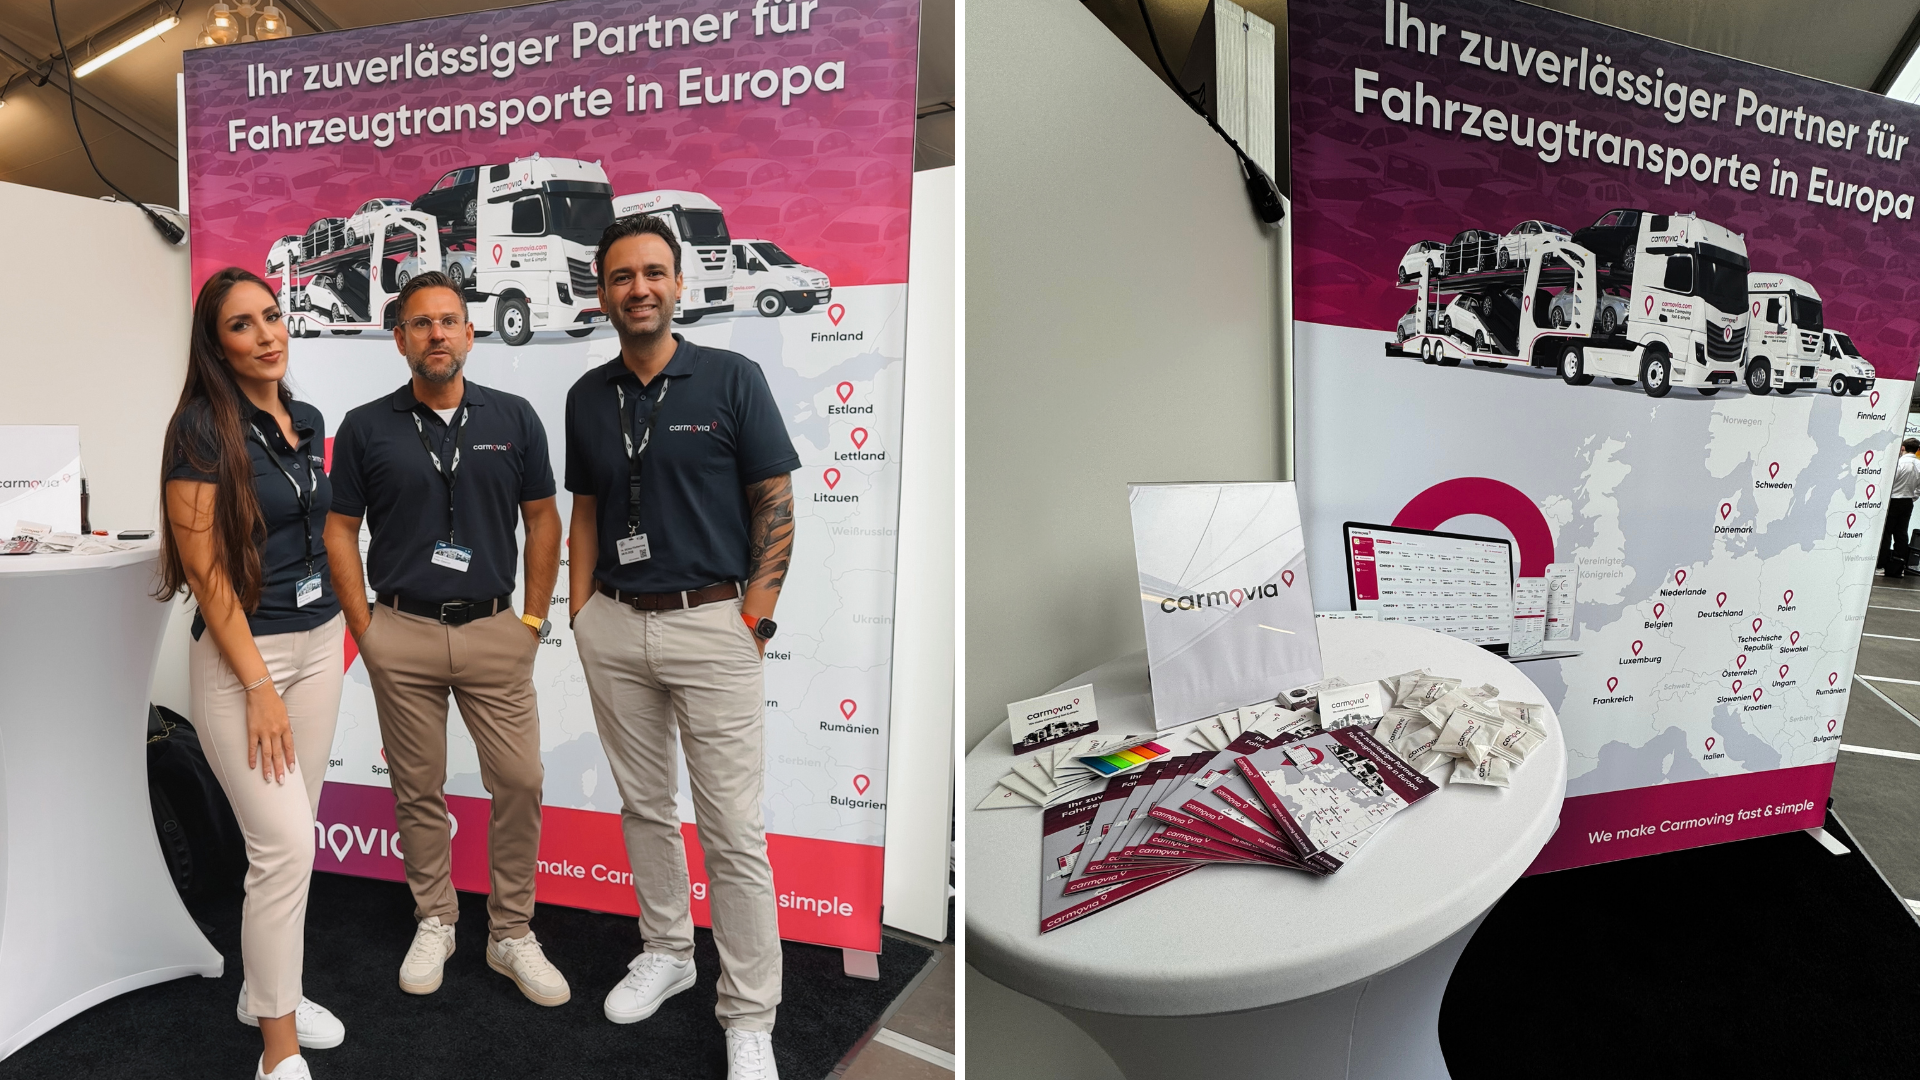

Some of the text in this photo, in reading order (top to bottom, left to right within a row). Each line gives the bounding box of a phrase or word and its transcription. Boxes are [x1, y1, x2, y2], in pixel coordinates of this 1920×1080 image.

[246, 0, 819, 98] Ihr zuverlässiger Partner für
[1384, 0, 1909, 162] Ihr zuverlässiger Partner für
[228, 60, 846, 153] Fahrzeugtransporte in Europa
[1354, 69, 1914, 223] Fahrzeugtransporte in Europa
[811, 331, 863, 342] Finnland
[828, 404, 873, 415] Estland
[1723, 415, 1762, 427] Norwegen
[1857, 412, 1886, 421] Finnland
[669, 424, 710, 433] carmovia
[473, 443, 507, 452] carmovia
[834, 451, 886, 461] Lettland
[1857, 467, 1881, 475] Estland
[1755, 481, 1793, 489] Schweden
[813, 493, 859, 503] Litauen
[1855, 501, 1881, 509] Lettland
[1714, 525, 1753, 534] Dänemark
[1839, 531, 1863, 539] Litauen
[1579, 557, 1625, 566] Vereinigtes
[1580, 571, 1624, 580] Königreich
[1660, 588, 1707, 597] Niederlande
[1161, 583, 1278, 613] carmovia
[1777, 604, 1796, 612] Polen
[1698, 610, 1743, 618] Deutschland
[1845, 614, 1865, 622] Ukrain
[852, 614, 892, 625] Ukrain
[1644, 621, 1673, 630] Belgien
[1738, 634, 1782, 643] Tschechische
[1744, 643, 1773, 652] Republik
[1780, 645, 1809, 654] Slowakei
[1619, 656, 1662, 665] Luxemburg
[1722, 668, 1757, 677] Österreich
[1664, 682, 1690, 690] Schweiz
[1772, 680, 1796, 688] Ungarn
[1815, 687, 1846, 696] Rumänien
[1593, 695, 1633, 705] Frankreich
[1717, 694, 1752, 703] Slowenien
[1331, 698, 1365, 709] carmovia
[1743, 703, 1772, 712] Kroatien
[1027, 704, 1072, 720] carmovia
[1789, 715, 1813, 723] Serbien
[819, 721, 879, 735] Rumänien
[1813, 734, 1842, 743] Bulgarien
[777, 754, 822, 768] Serbien
[1703, 752, 1725, 761] Italien
[830, 795, 887, 811] Bulgarien
[1068, 800, 1083, 808] Ihr
[1186, 802, 1217, 820] carmovia
[1152, 810, 1186, 824] carmovia
[1588, 799, 1814, 844] We make Carmoving fast & simple
[1166, 831, 1203, 843] carmovia
[1139, 848, 1180, 856] carmovia
[1070, 873, 1119, 890] carmovia
[778, 891, 853, 917] simple
[1047, 900, 1100, 928] carmovia
